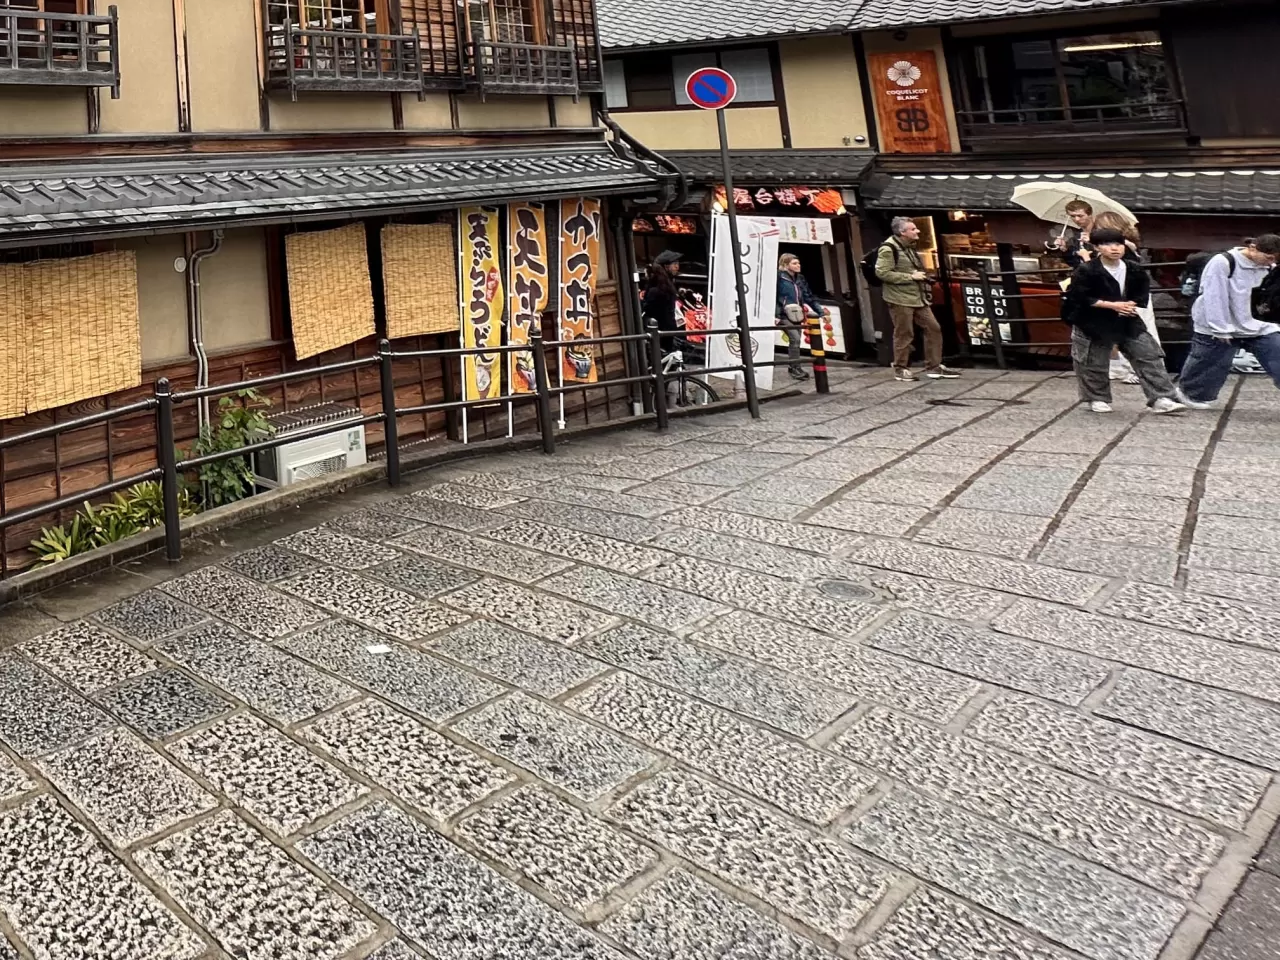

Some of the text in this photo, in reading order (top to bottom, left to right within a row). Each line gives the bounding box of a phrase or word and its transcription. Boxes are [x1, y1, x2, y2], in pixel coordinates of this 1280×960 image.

[886, 88, 929, 96] COQUELICOT
[513, 208, 547, 336] 天丼
[564, 201, 600, 331] かつ丼
